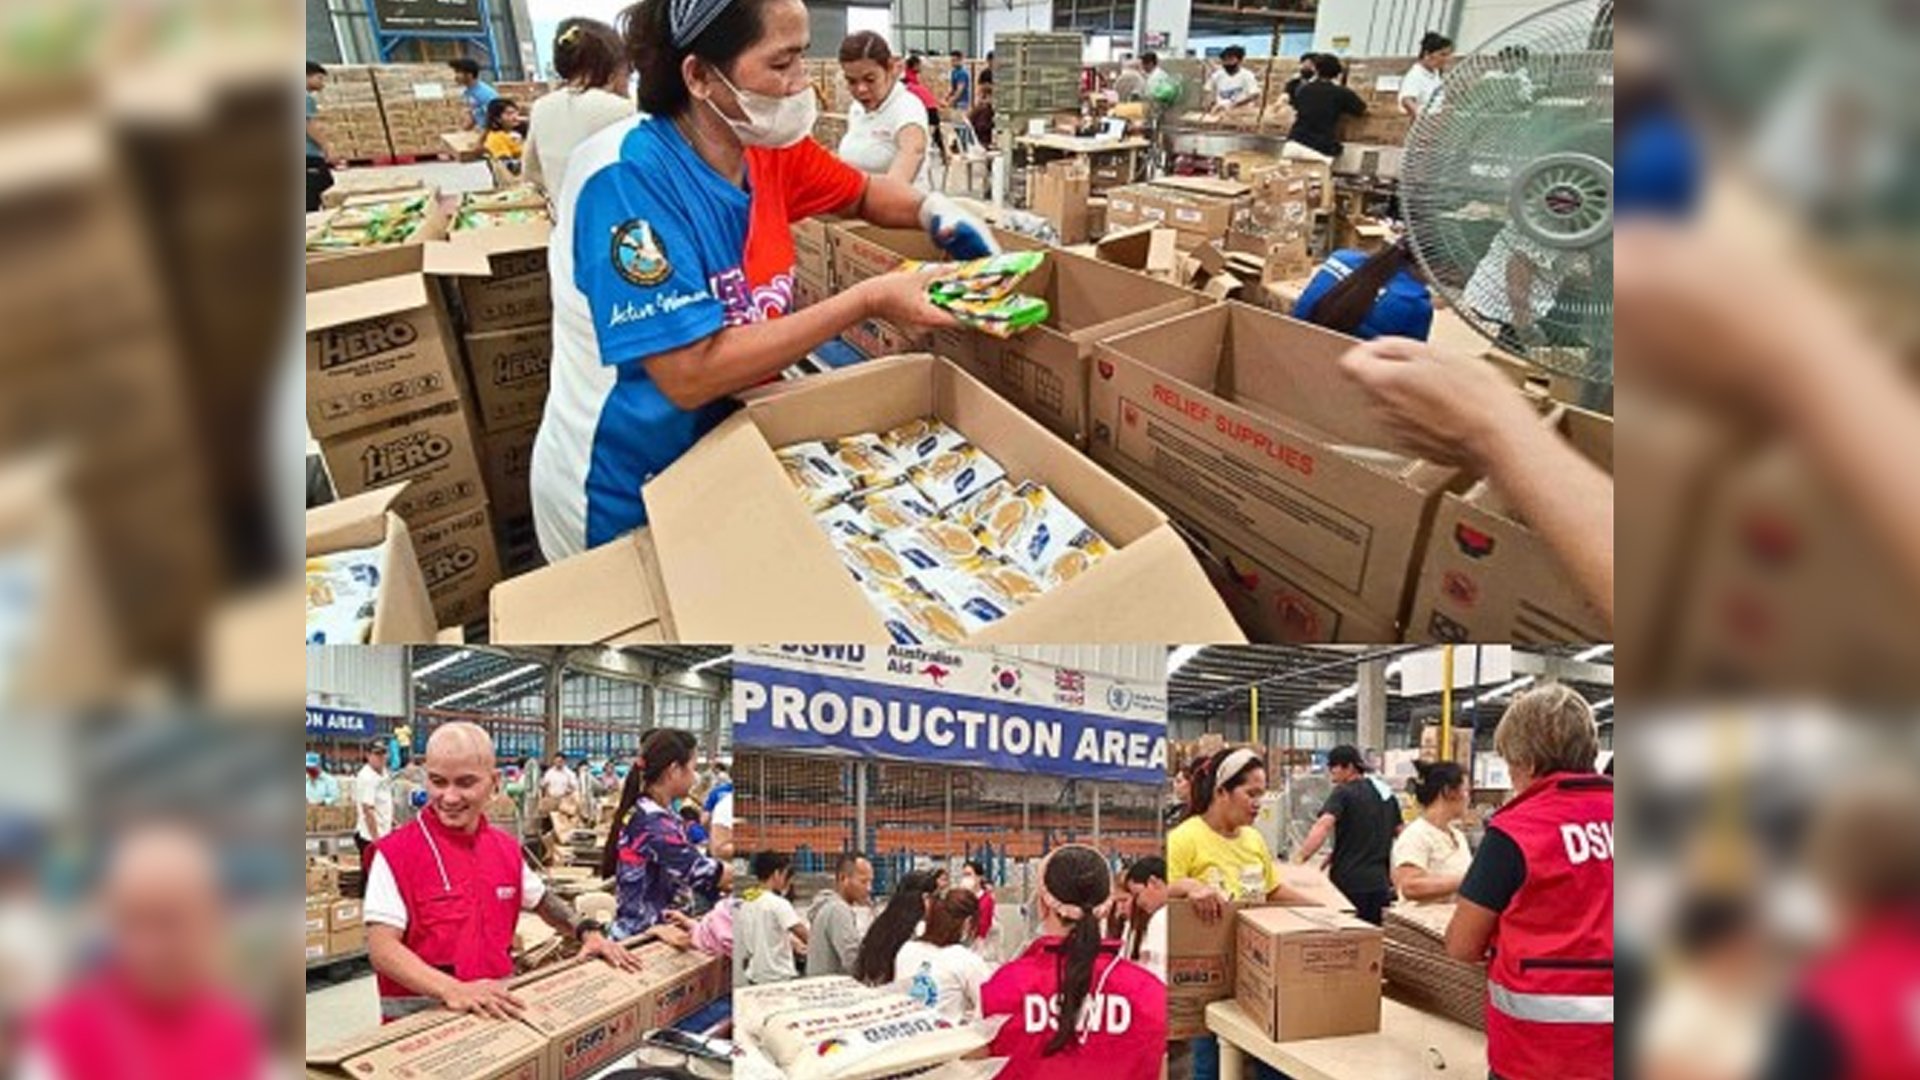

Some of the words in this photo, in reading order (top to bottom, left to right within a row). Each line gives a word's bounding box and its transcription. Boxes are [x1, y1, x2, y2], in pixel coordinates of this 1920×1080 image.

[608, 300, 656, 329] Active
[319, 318, 418, 370] HERO
[1152, 384, 1212, 422] RELIEF
[1215, 414, 1315, 476] SUPPLIES
[362, 432, 453, 486] HERO
[420, 547, 478, 588] ERO
[887, 645, 963, 667] Australian
[887, 660, 913, 674] Aid
[328, 713, 364, 730] AREA
[733, 681, 1062, 760] PRODUCTION
[1074, 727, 1167, 770] AREA
